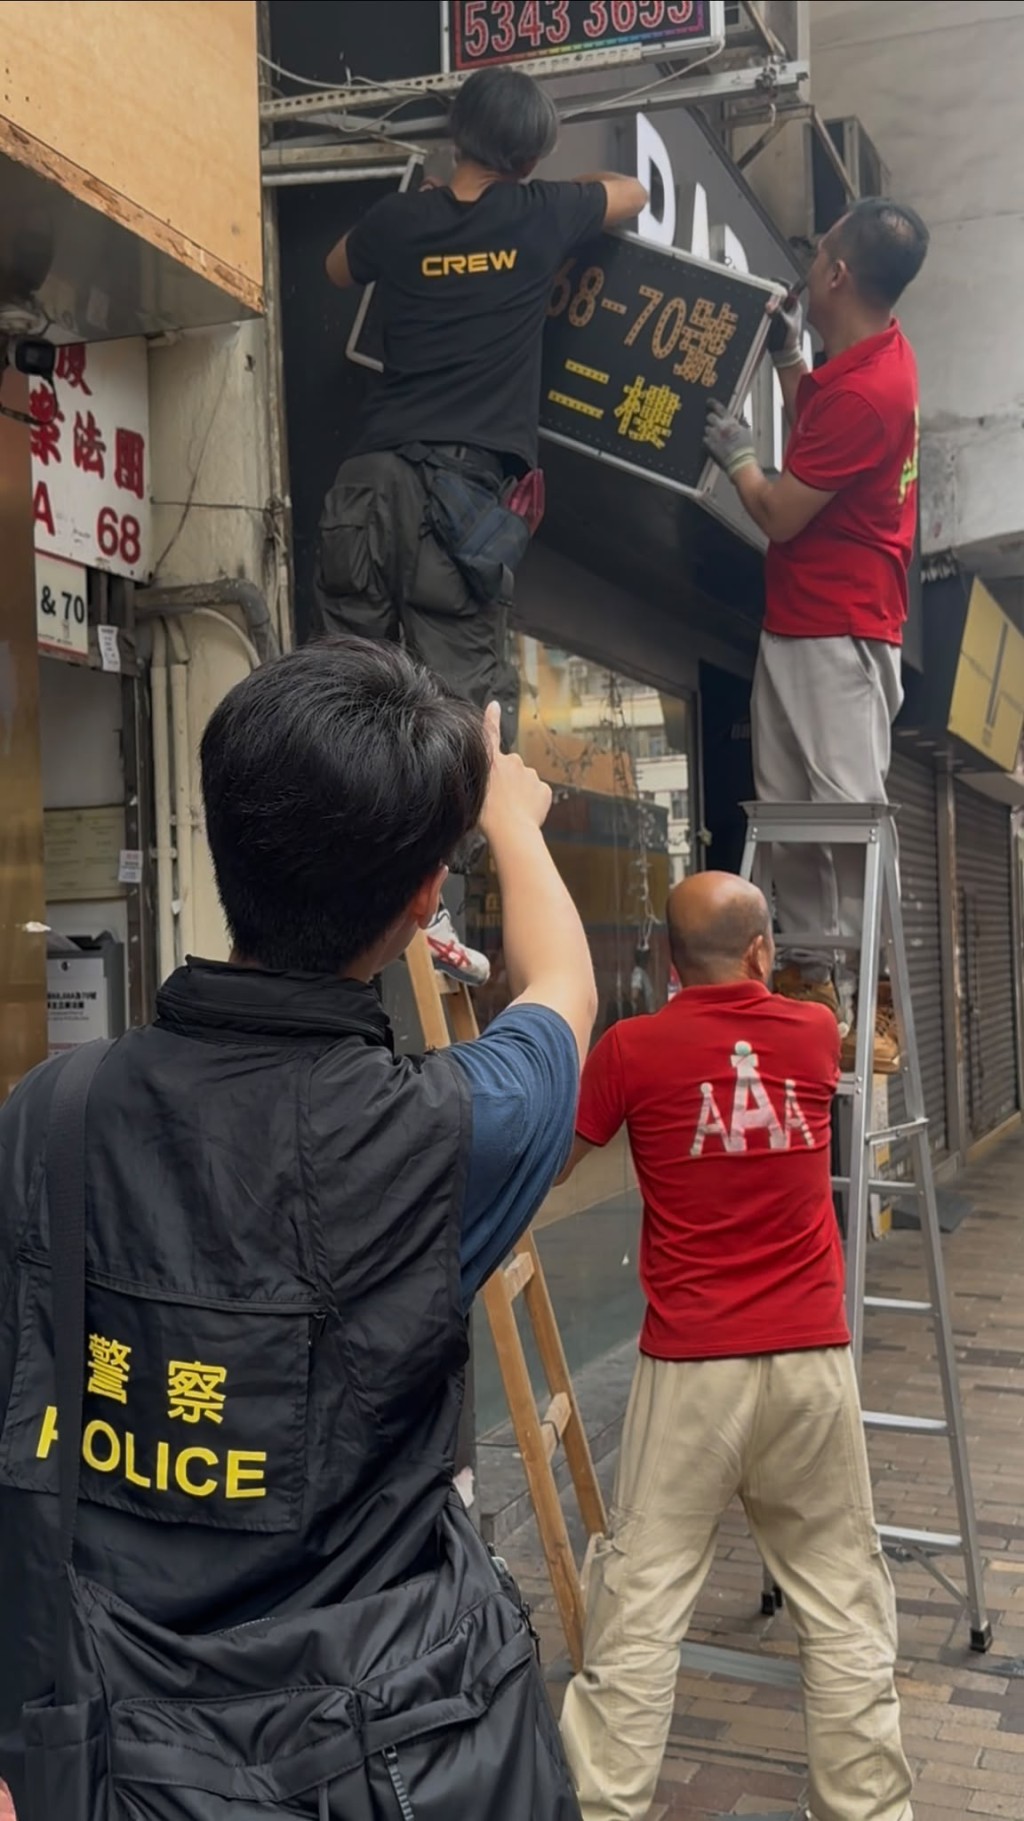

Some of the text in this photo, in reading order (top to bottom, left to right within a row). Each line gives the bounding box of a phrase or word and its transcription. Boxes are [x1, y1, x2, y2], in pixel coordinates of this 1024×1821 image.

[464, 0, 571, 57] 5343
[422, 248, 517, 276] CREW
[548, 358, 681, 450] 二樓
[97, 507, 142, 565] 68
[41, 586, 86, 625] & 70
[87, 1333, 228, 1425] 警察
